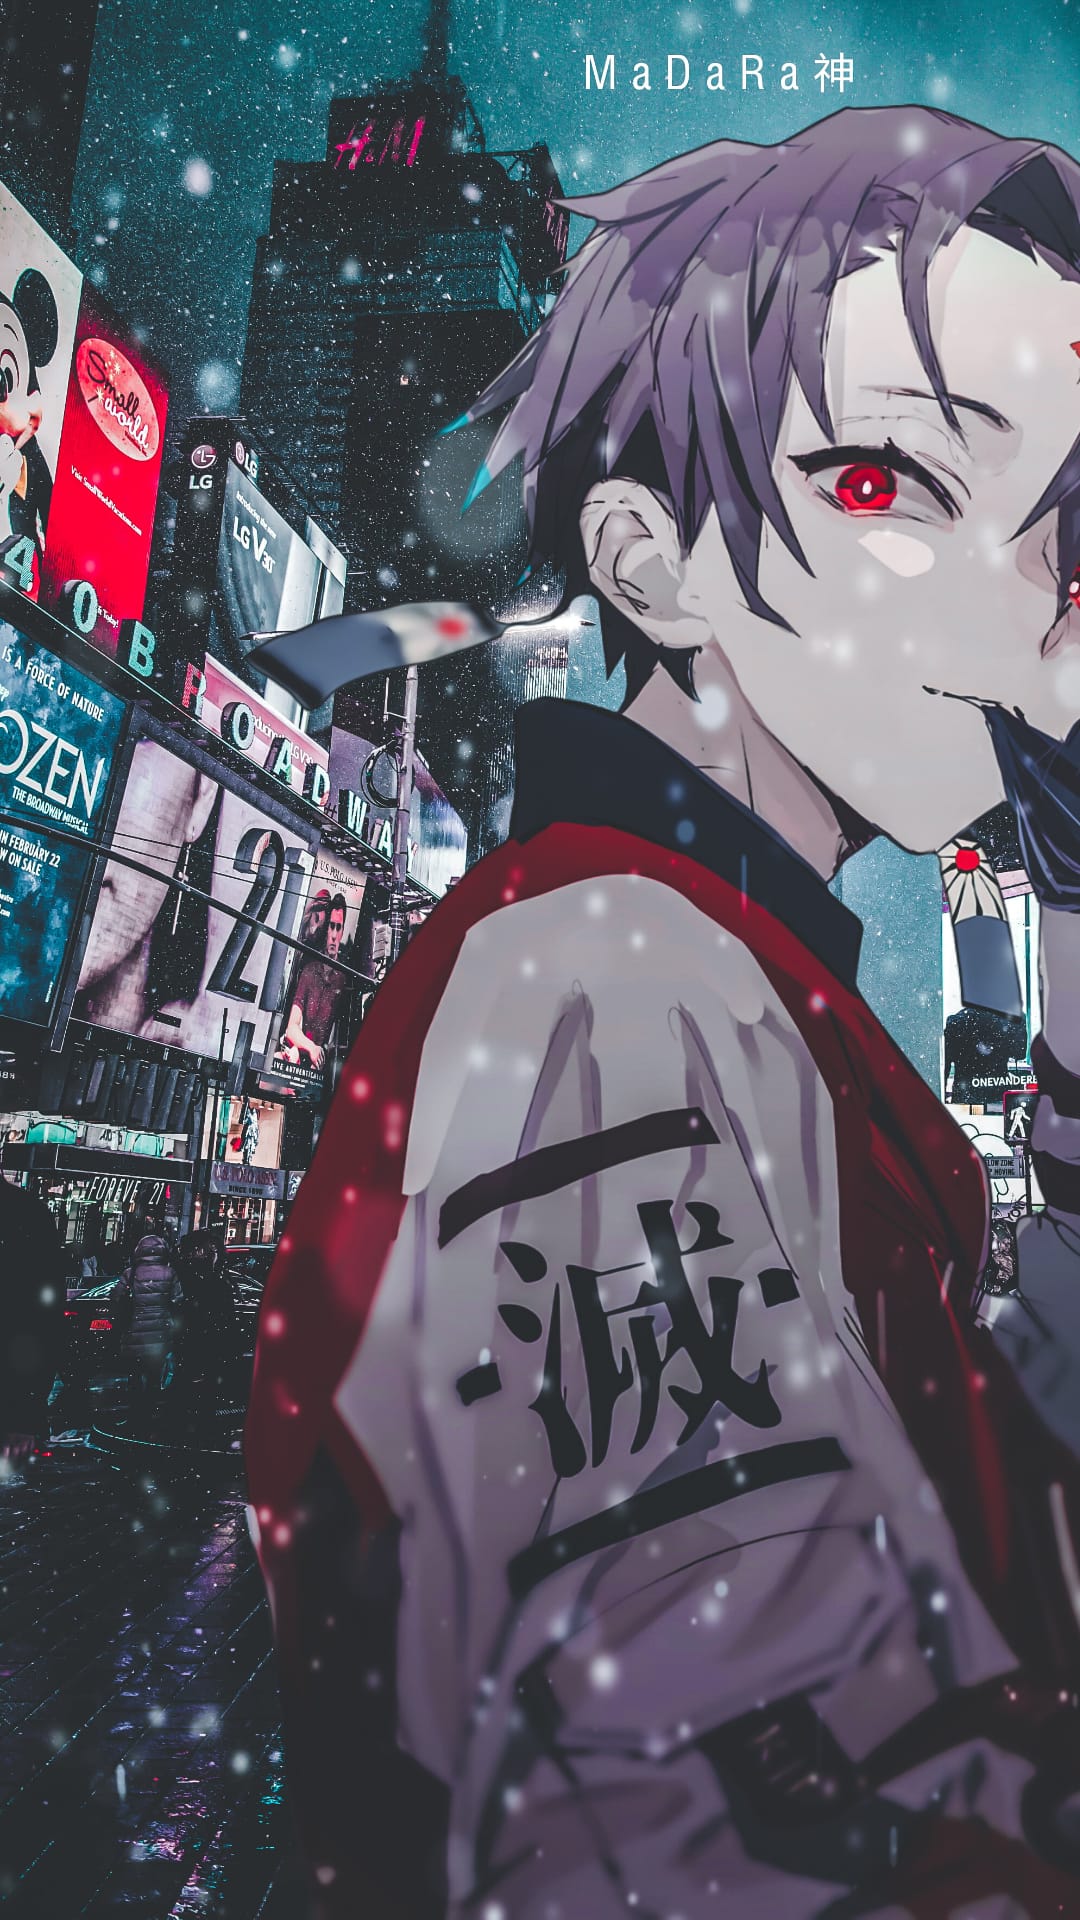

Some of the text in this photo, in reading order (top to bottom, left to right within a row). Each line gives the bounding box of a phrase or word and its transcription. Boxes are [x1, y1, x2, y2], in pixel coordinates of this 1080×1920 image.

[87, 350, 140, 420] Small
[104, 394, 149, 449] world
[189, 475, 213, 489] LG
[244, 452, 258, 478] LG
[236, 490, 260, 525] Introducing
[233, 516, 250, 550] LG
[2, 645, 105, 722] IS A FORCE OF NATURE
[12, 785, 89, 835] THE BROADWAY MUSICAL
[8, 852, 22, 868] ON
[21, 859, 43, 877] SALE
[9, 834, 50, 863] FEBRUARY
[49, 853, 61, 868] 22
[195, 827, 315, 1014] 21
[995, 1168, 1016, 1176] MOVING
[149, 1182, 165, 1205] 21
[497, 1199, 783, 1479] 滅
